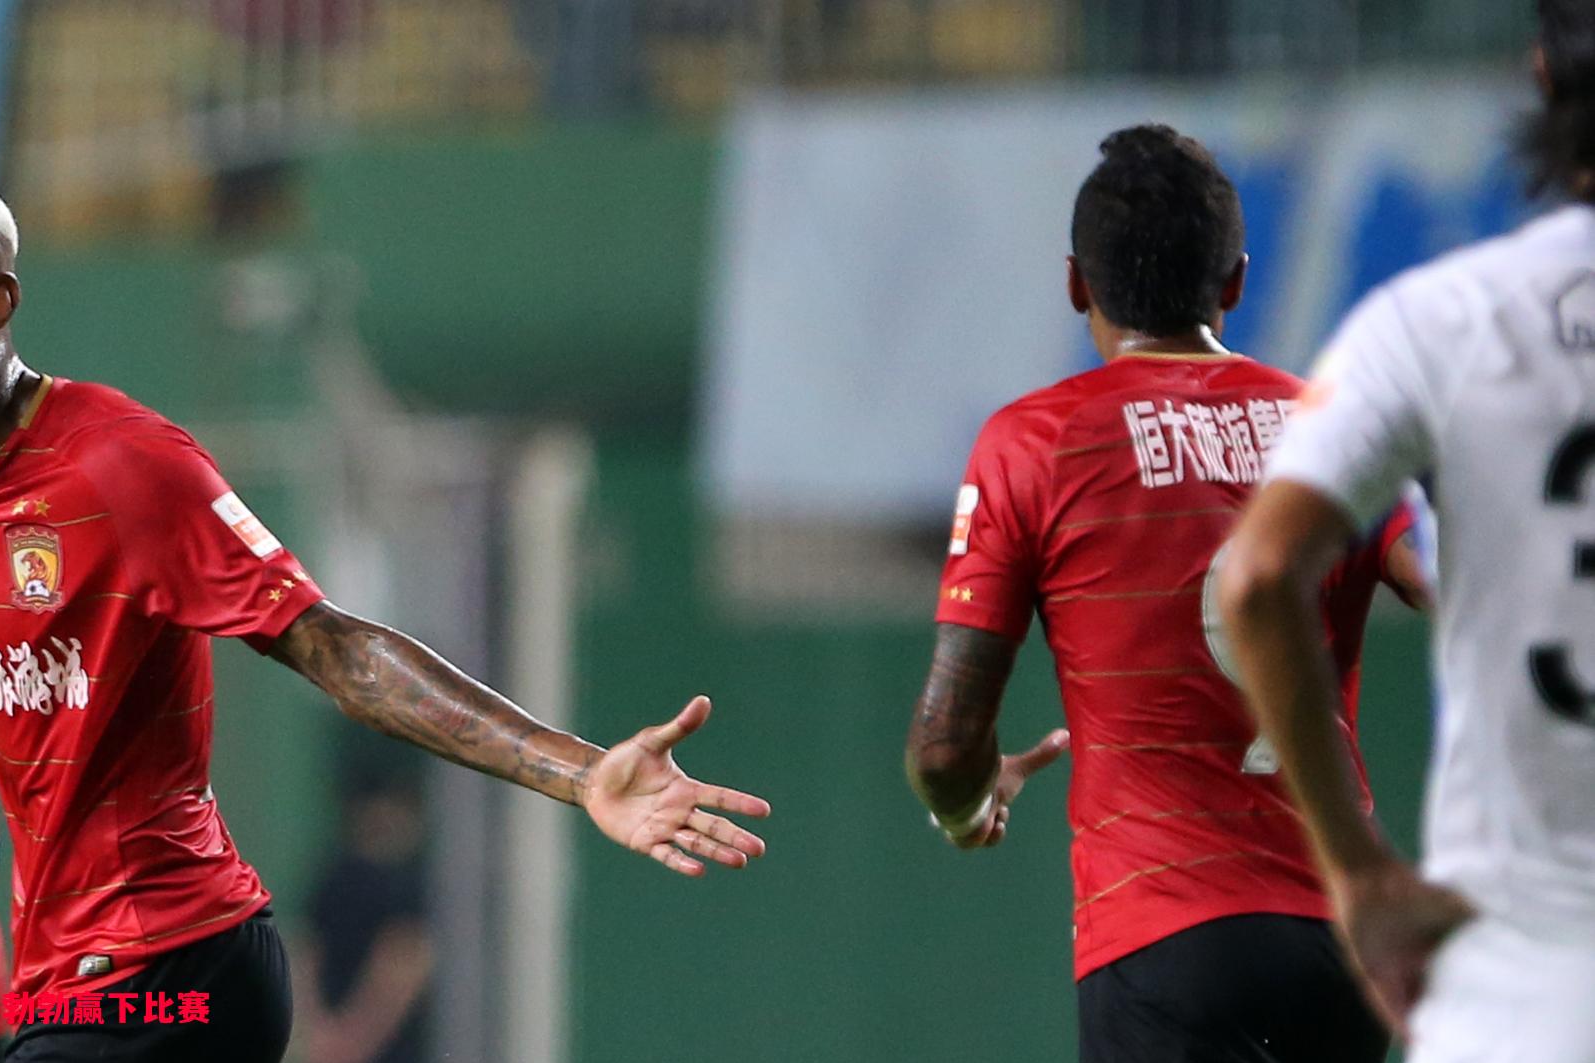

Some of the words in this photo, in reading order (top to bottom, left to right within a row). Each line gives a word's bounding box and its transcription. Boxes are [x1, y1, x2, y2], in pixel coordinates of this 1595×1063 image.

[1123, 399, 1298, 489] 恒大旅游集
